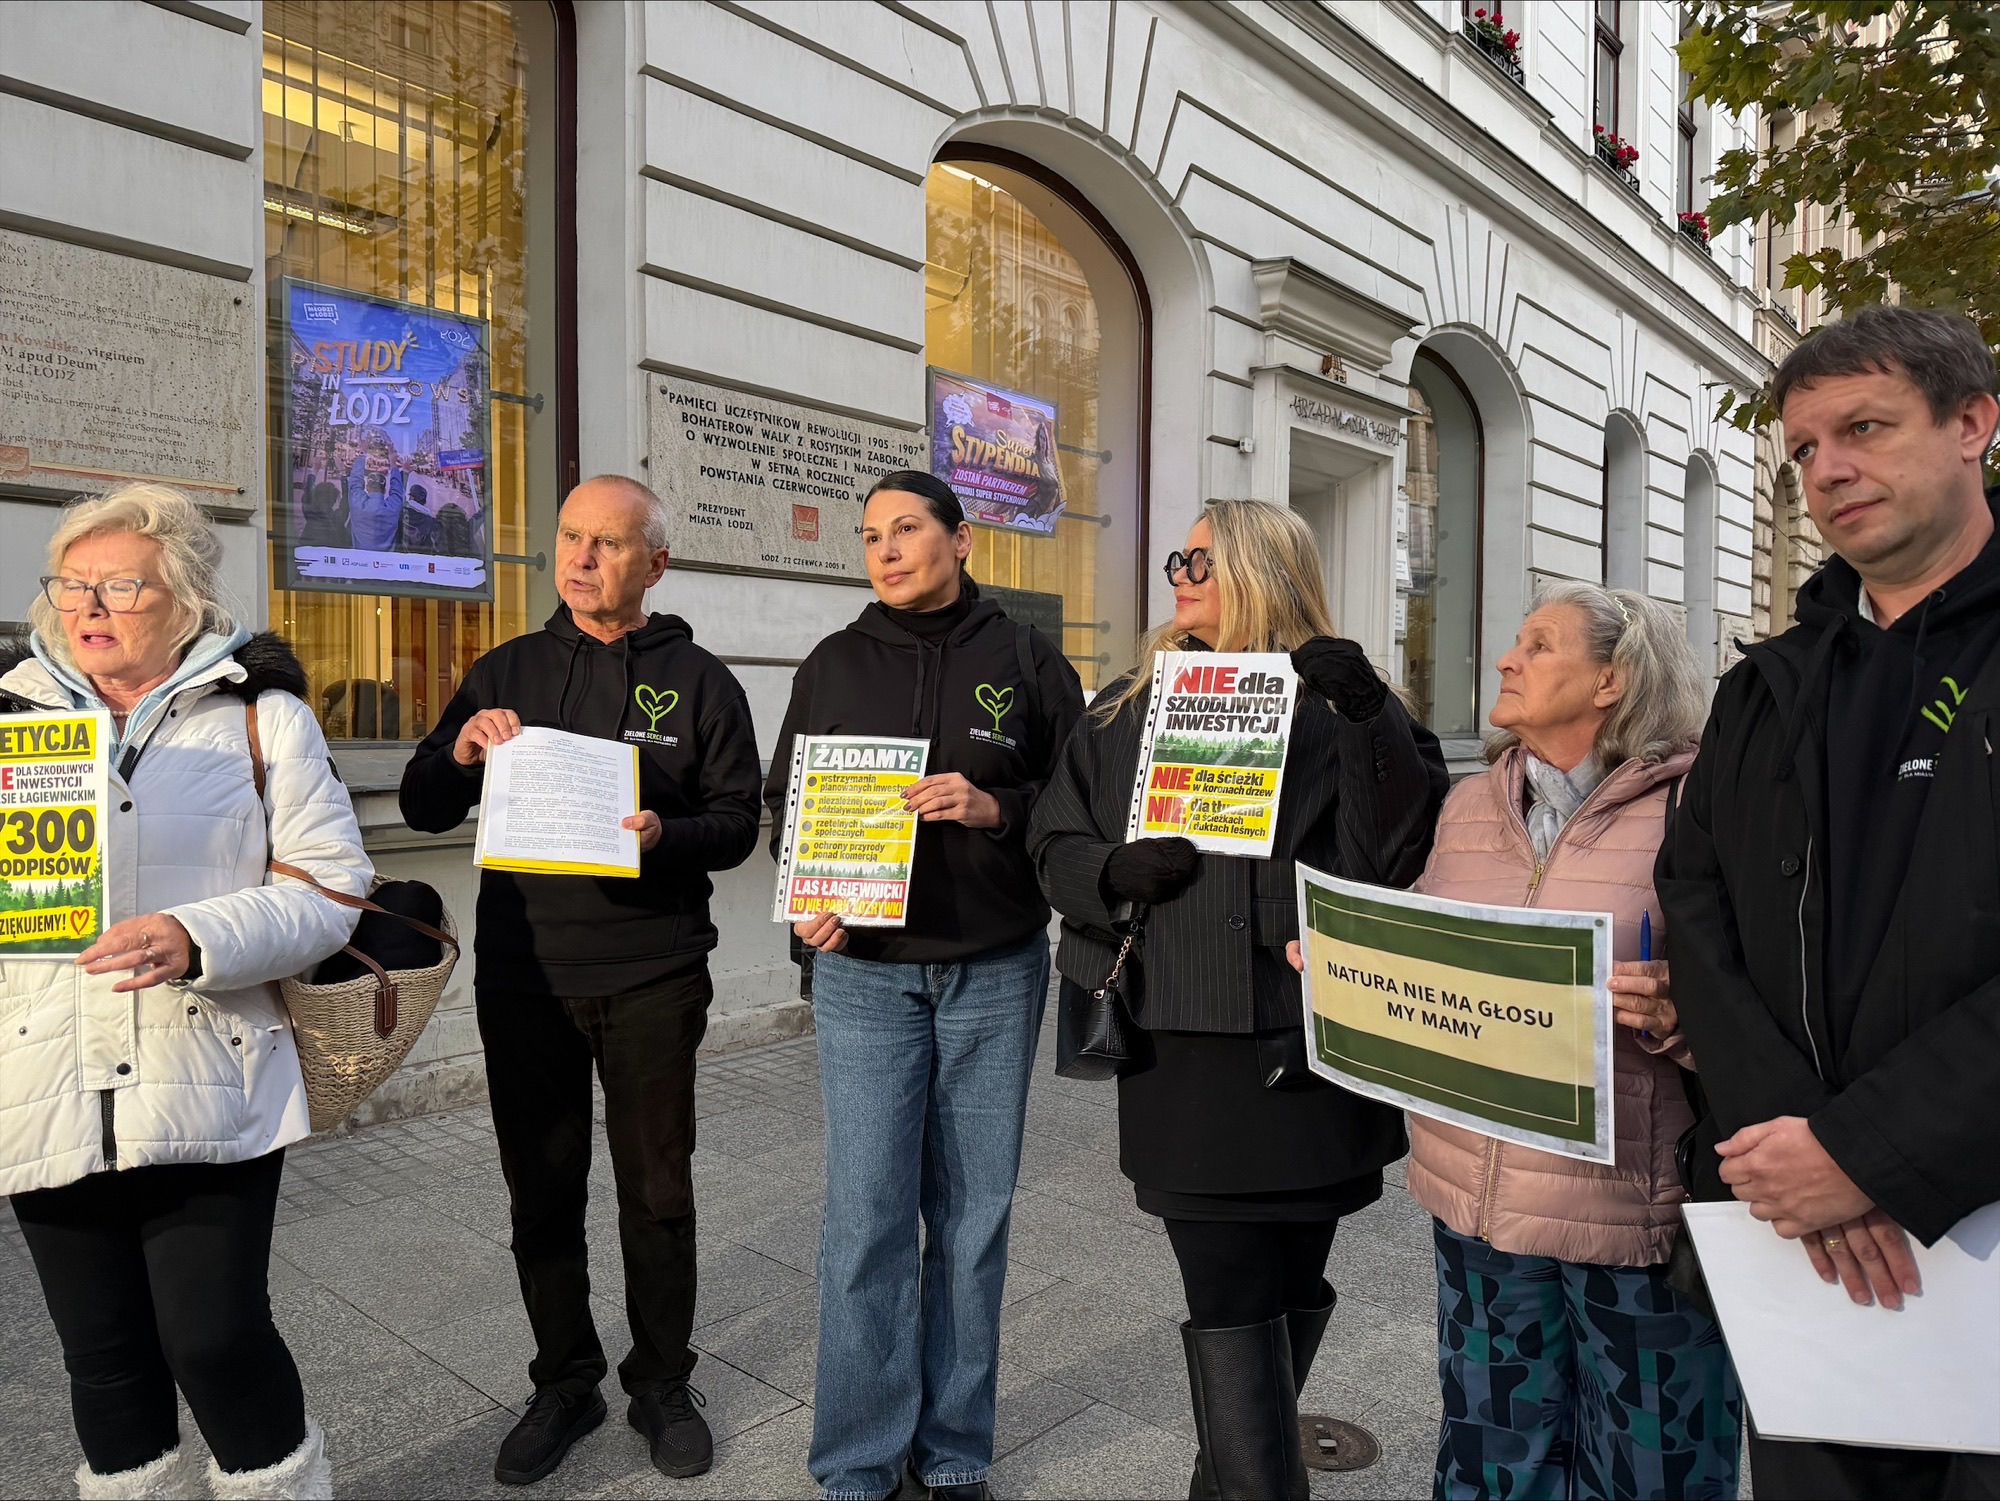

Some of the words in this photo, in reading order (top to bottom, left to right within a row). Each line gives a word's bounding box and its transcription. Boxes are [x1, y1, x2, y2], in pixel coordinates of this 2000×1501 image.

[18, 351, 53, 364] apud
[57, 354, 98, 372] Deum
[87, 347, 145, 364] virginem
[313, 339, 408, 374] STUDY
[321, 374, 341, 391] IN
[686, 430, 695, 441] O
[703, 432, 776, 457] WYZWOLENIE
[844, 460, 848, 471] I
[761, 428, 791, 444] WALK
[797, 436, 804, 447] Z
[810, 439, 861, 458] ROSYJSKIM
[868, 437, 889, 449] 1905
[898, 443, 919, 456] 1907
[996, 429, 1036, 457] Super
[951, 425, 1041, 479] STYPENDIA
[751, 458, 761, 469] W
[700, 465, 766, 487] POWSTANIA
[772, 478, 850, 502] CZERWCOWEGO
[855, 492, 864, 503] W
[954, 468, 982, 485] ZOSTAŃ
[981, 476, 1028, 495] PARTNEREM
[976, 488, 993, 501] SUPER
[993, 492, 1029, 506] STYPENDIUM
[697, 502, 746, 518] PREZYDENT
[689, 514, 723, 527] MIASTA
[728, 519, 754, 531] ŁODZI
[783, 556, 791, 564] 22
[793, 557, 823, 567] CZERWCA
[825, 561, 840, 570] 2005
[1173, 666, 1239, 694] NIE
[1238, 672, 1285, 695] dla
[1165, 695, 1288, 715] SZKODLIWYCH
[1165, 714, 1280, 734] INWESTYCJI
[0, 723, 91, 753] ETYCJA
[624, 730, 646, 738] ZIELONE
[646, 732, 662, 741] SERCE
[813, 743, 918, 771] ŻĄDAMY:
[16, 766, 32, 777] DLA
[34, 763, 94, 776] SZKODLIWYCH
[1151, 766, 1194, 791] NIE
[1195, 769, 1215, 782] dla
[1217, 771, 1264, 786] ścieżki
[16, 776, 82, 790] INWESTYCJI
[821, 774, 877, 784] wstrzymania
[20, 789, 96, 803] ŁAGIEWNICKIM
[820, 783, 872, 793] planowanych
[1193, 783, 1201, 791] w
[1203, 783, 1245, 796] koronach
[1246, 786, 1273, 797] drzew
[818, 796, 863, 807] niezależnej
[864, 798, 887, 807] oceny
[818, 806, 865, 816] oddziaływania
[1146, 796, 1187, 825] NIE
[1190, 798, 1209, 813] dla
[1202, 813, 1244, 825] ścieżkach
[0, 808, 95, 855] 300
[815, 828, 865, 838] społecznych
[816, 819, 858, 829] rzetelnych
[860, 819, 904, 831] konsultacji
[1193, 822, 1229, 833] duktach
[1231, 825, 1265, 838] leśnych
[813, 841, 847, 851] ochrony
[849, 842, 885, 852] przyrody
[0, 852, 91, 877] ODPISÓW
[812, 850, 838, 860] ponad
[840, 850, 878, 862] komercją
[794, 879, 820, 896] LAS
[821, 880, 903, 899] ŁAGIEWNICKI
[792, 897, 805, 911] TO
[806, 897, 822, 912] NIE
[1327, 961, 1399, 995] NATURA
[1403, 982, 1436, 1003] NIE
[1441, 990, 1473, 1014] MA
[1478, 1000, 1554, 1028] GŁOSU
[1387, 1002, 1416, 1022] MY
[1422, 1010, 1482, 1040] MAMY
